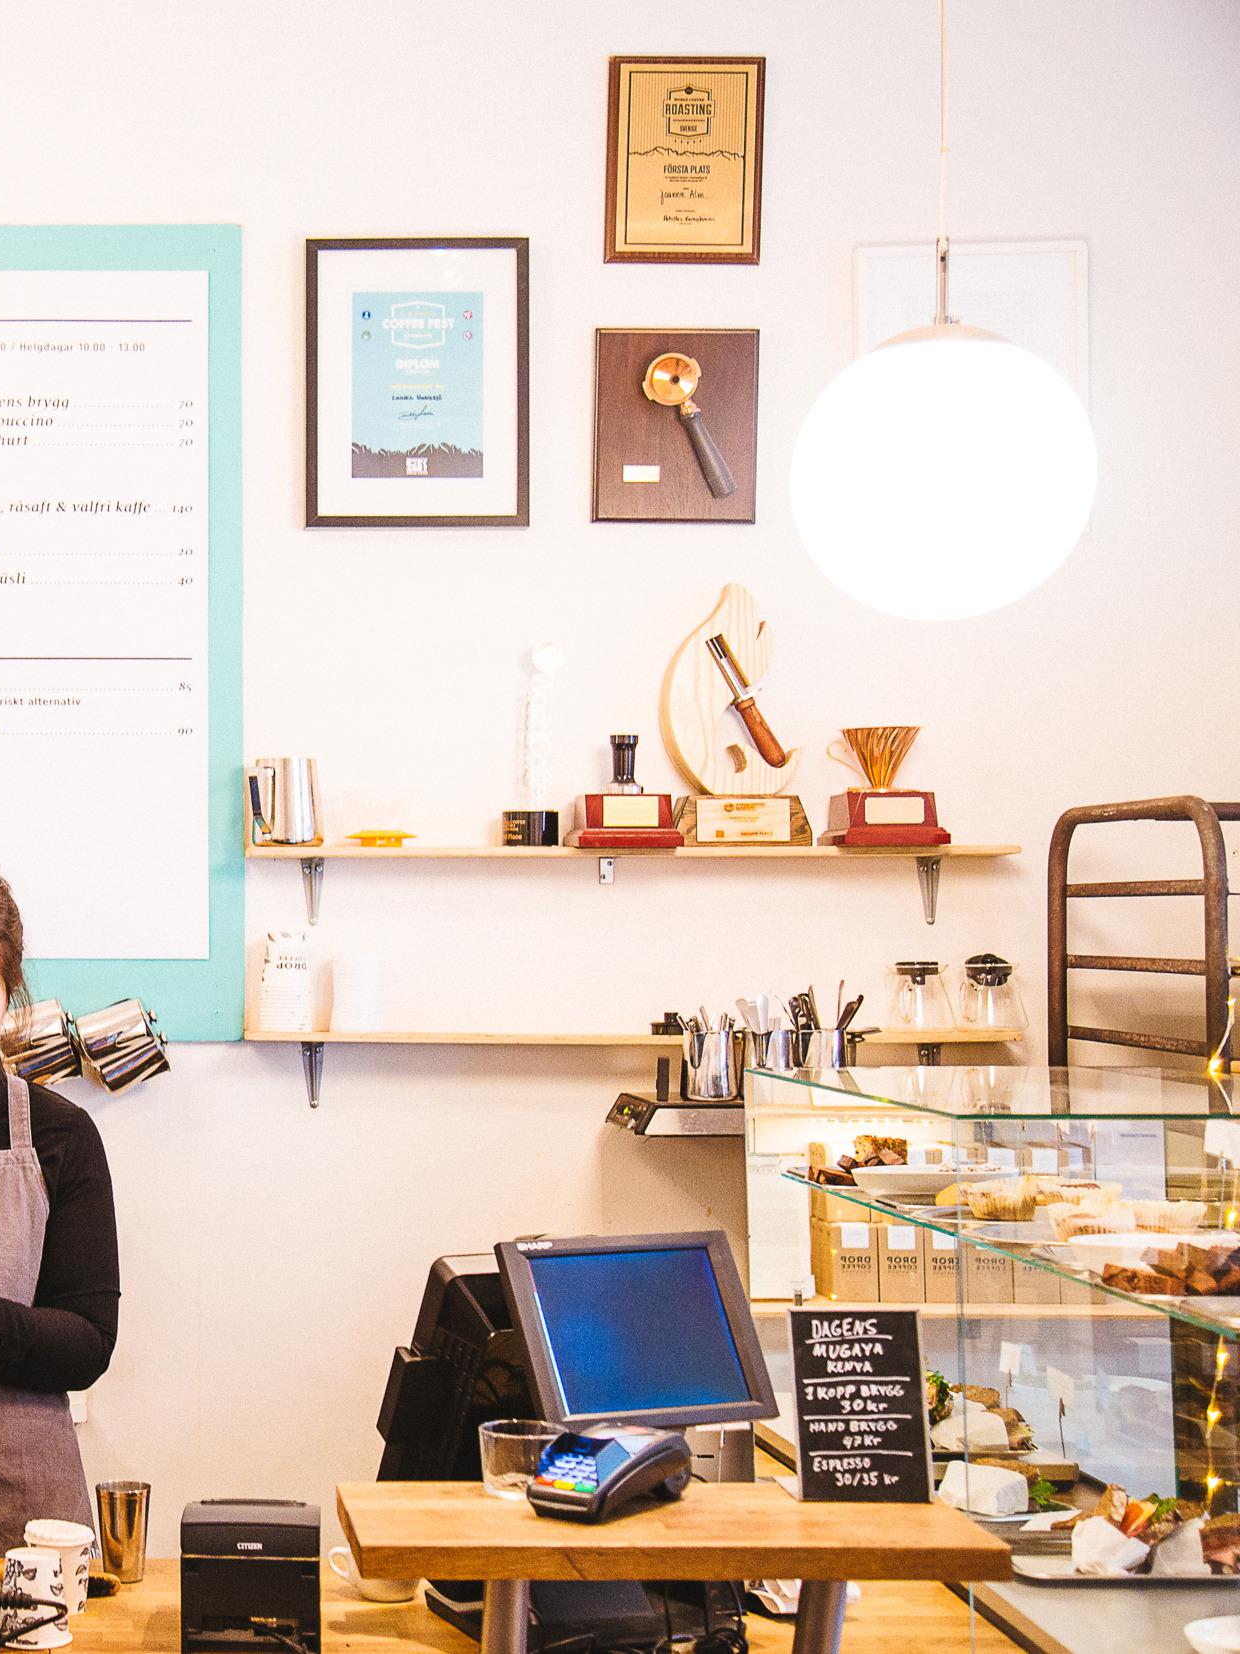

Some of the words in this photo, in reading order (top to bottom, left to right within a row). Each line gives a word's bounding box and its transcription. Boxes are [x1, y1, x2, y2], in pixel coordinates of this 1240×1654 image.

[665, 103, 712, 115] ROASTING
[663, 164, 689, 174] FÖRSTA
[690, 165, 711, 174] PLATS
[395, 359, 440, 369] DIPLOM
[28, 395, 69, 408] brygg
[9, 501, 50, 514] råsaft
[56, 501, 65, 512] &
[72, 500, 110, 514] valfri
[115, 500, 150, 514] kaffe
[28, 697, 80, 705] alternativ
[516, 1241, 553, 1252] SHARP
[811, 1317, 878, 1338] DAGENS
[812, 1343, 883, 1358] MUGAYA
[826, 1360, 873, 1374] KENYA
[817, 1384, 856, 1400] KOPP
[860, 1384, 905, 1397] BRYGG
[809, 1421, 845, 1433] HAND
[849, 1420, 898, 1433] BRYGG
[813, 1457, 871, 1474] ESPRESSO
[835, 1472, 879, 1487] 30/35
[237, 1542, 263, 1551] CITIZEN
